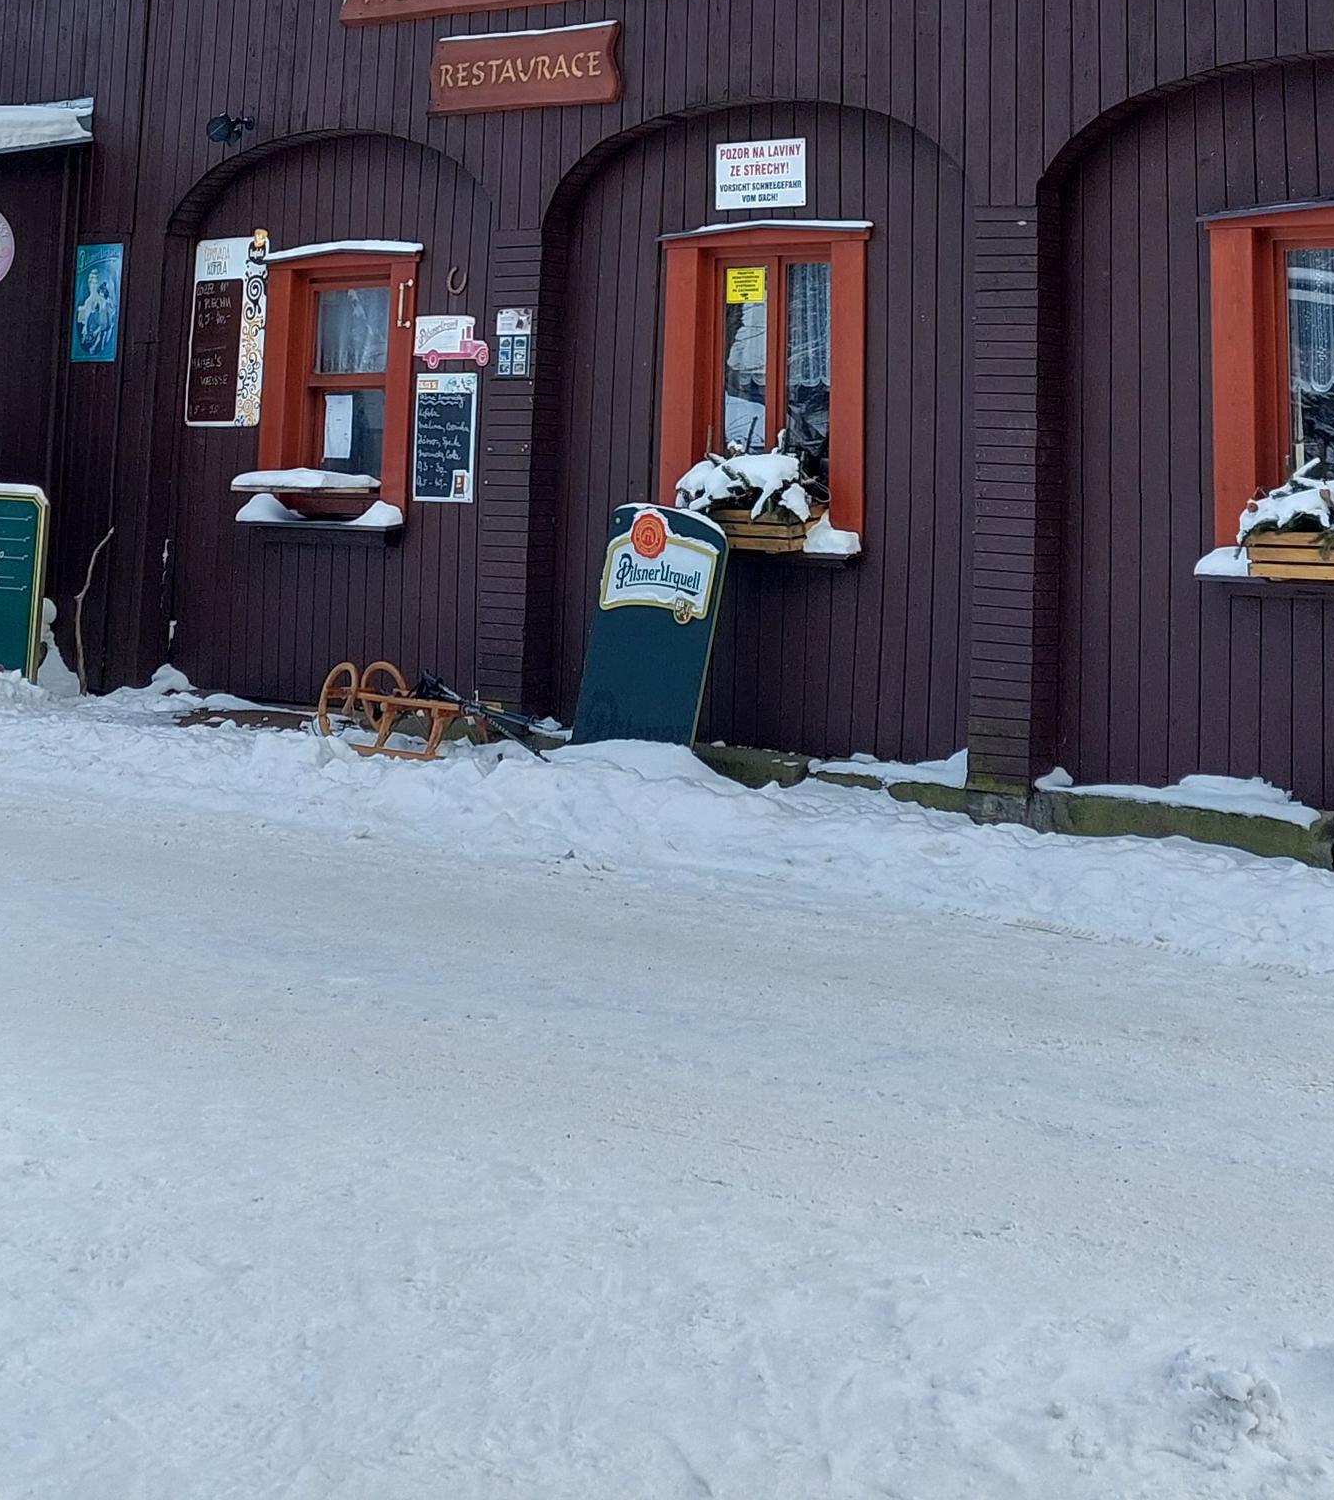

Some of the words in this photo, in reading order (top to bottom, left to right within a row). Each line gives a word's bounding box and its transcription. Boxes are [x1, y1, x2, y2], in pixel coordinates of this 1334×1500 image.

[720, 147, 750, 161] POZOR
[752, 145, 765, 158] NA
[767, 143, 802, 157] LAVINY
[730, 164, 741, 177] ZE
[743, 160, 789, 176] STŘECHY!
[719, 182, 751, 193] VORSICHT
[741, 194, 756, 203] VOM
[758, 192, 779, 202] DACH!
[615, 553, 661, 590] Pilsner
[660, 560, 702, 593] Urquell
